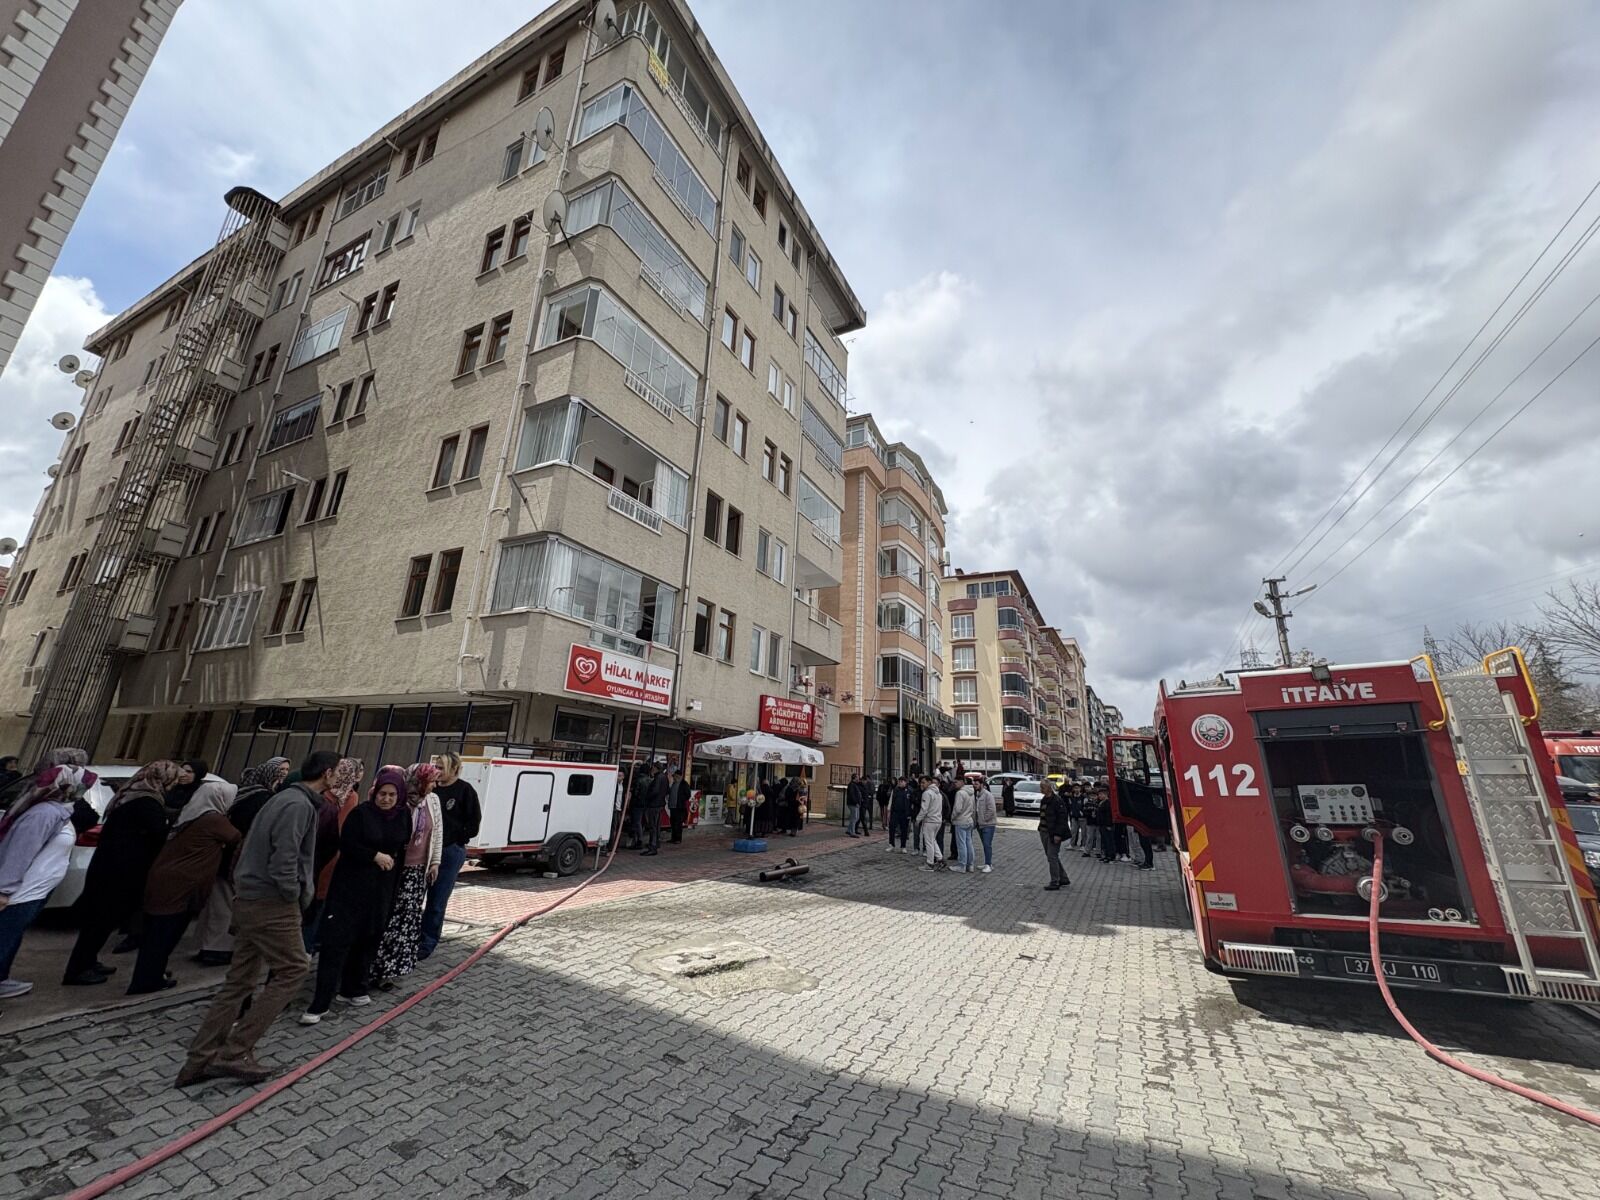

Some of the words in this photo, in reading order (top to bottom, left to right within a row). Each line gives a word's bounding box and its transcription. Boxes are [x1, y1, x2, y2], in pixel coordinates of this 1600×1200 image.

[604, 661, 632, 680] HİLAL
[606, 685, 634, 697] OYUNCAK
[1573, 745, 1600, 754] TOSY
[1183, 763, 1260, 797] 112
[1353, 959, 1370, 973] 37
[1411, 965, 1437, 980] 110
